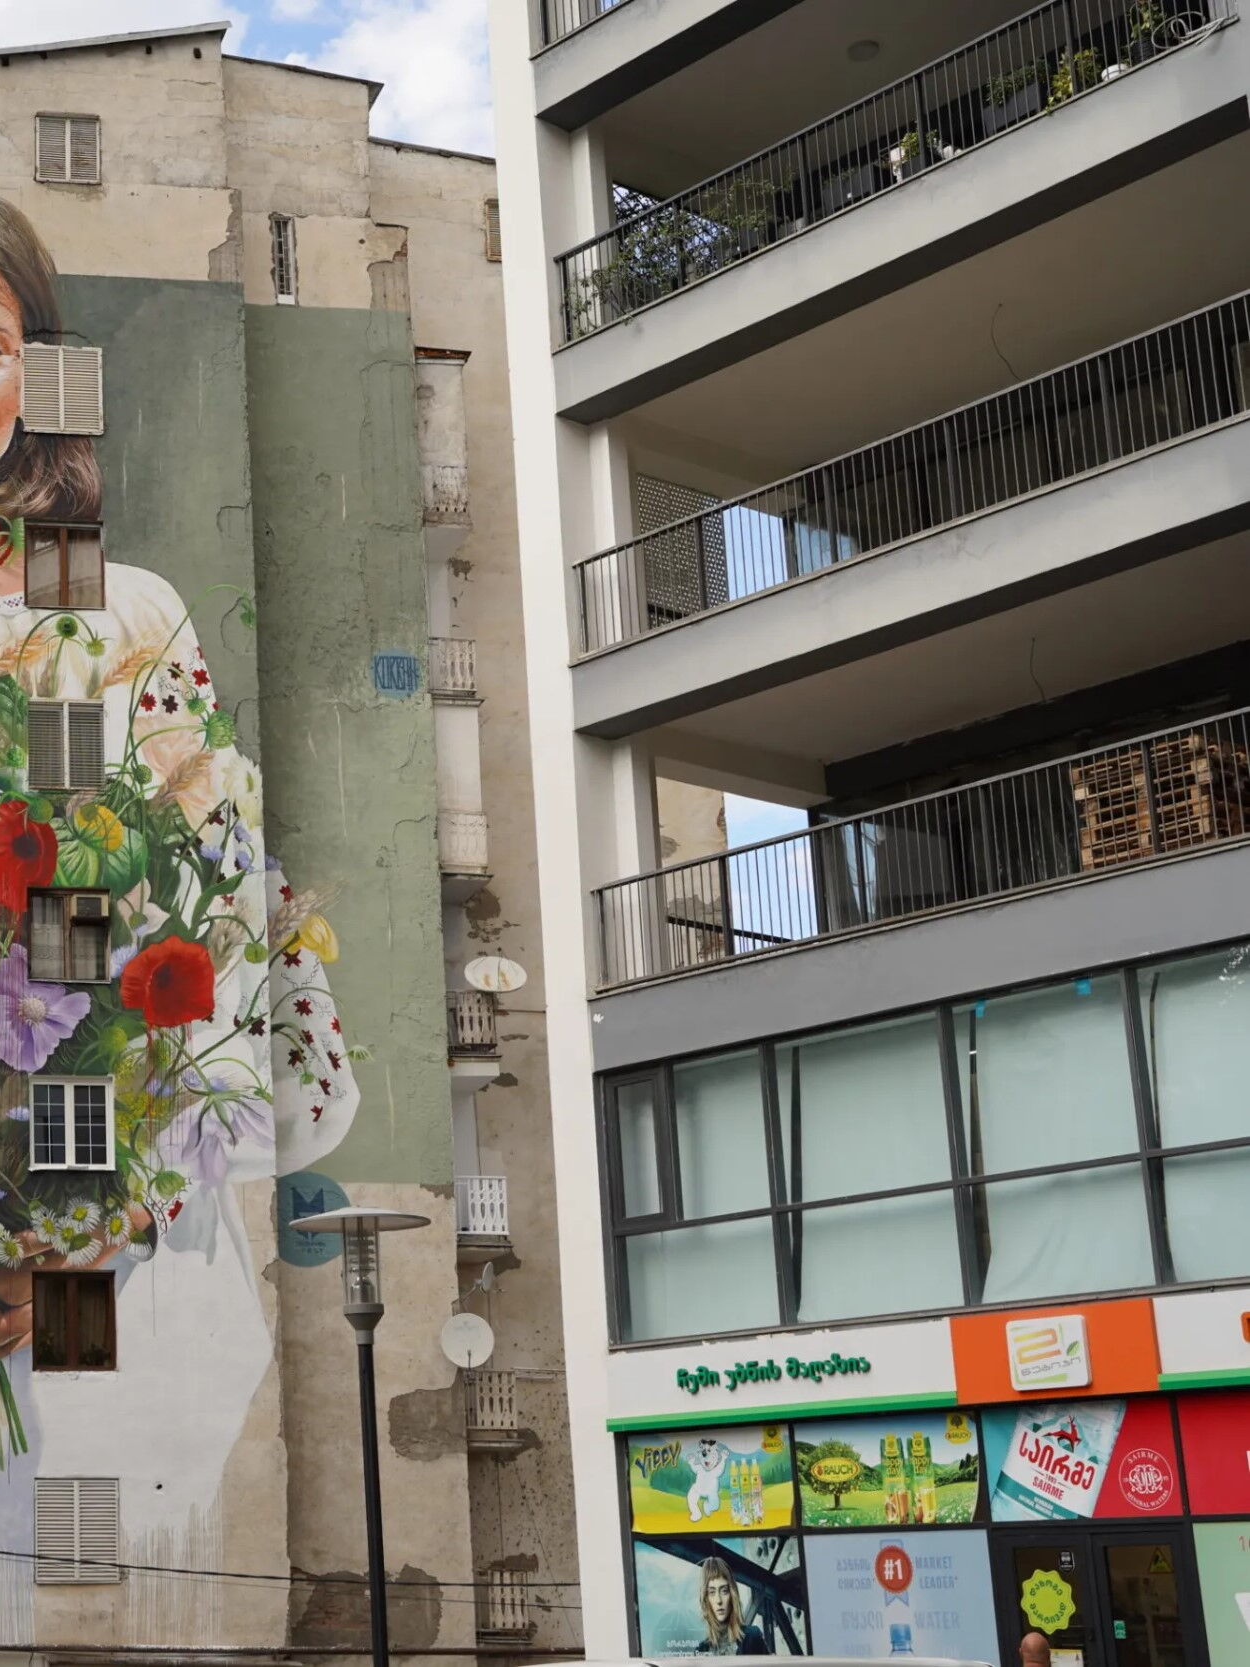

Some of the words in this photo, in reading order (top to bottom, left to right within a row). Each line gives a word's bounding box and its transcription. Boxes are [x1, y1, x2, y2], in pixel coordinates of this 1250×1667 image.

[676, 1366, 720, 1394] ჩემი
[724, 1359, 781, 1391] უბნის
[786, 1353, 871, 1383] მაღაზია
[1019, 1432, 1095, 1490] საირმე
[1128, 1451, 1159, 1464] SAIRME
[823, 1463, 854, 1475] RAUCH
[1032, 1476, 1065, 1501] SAIRME
[883, 1558, 904, 1580] #1
[915, 1556, 953, 1570] MARKET
[915, 1611, 961, 1630] WATER
